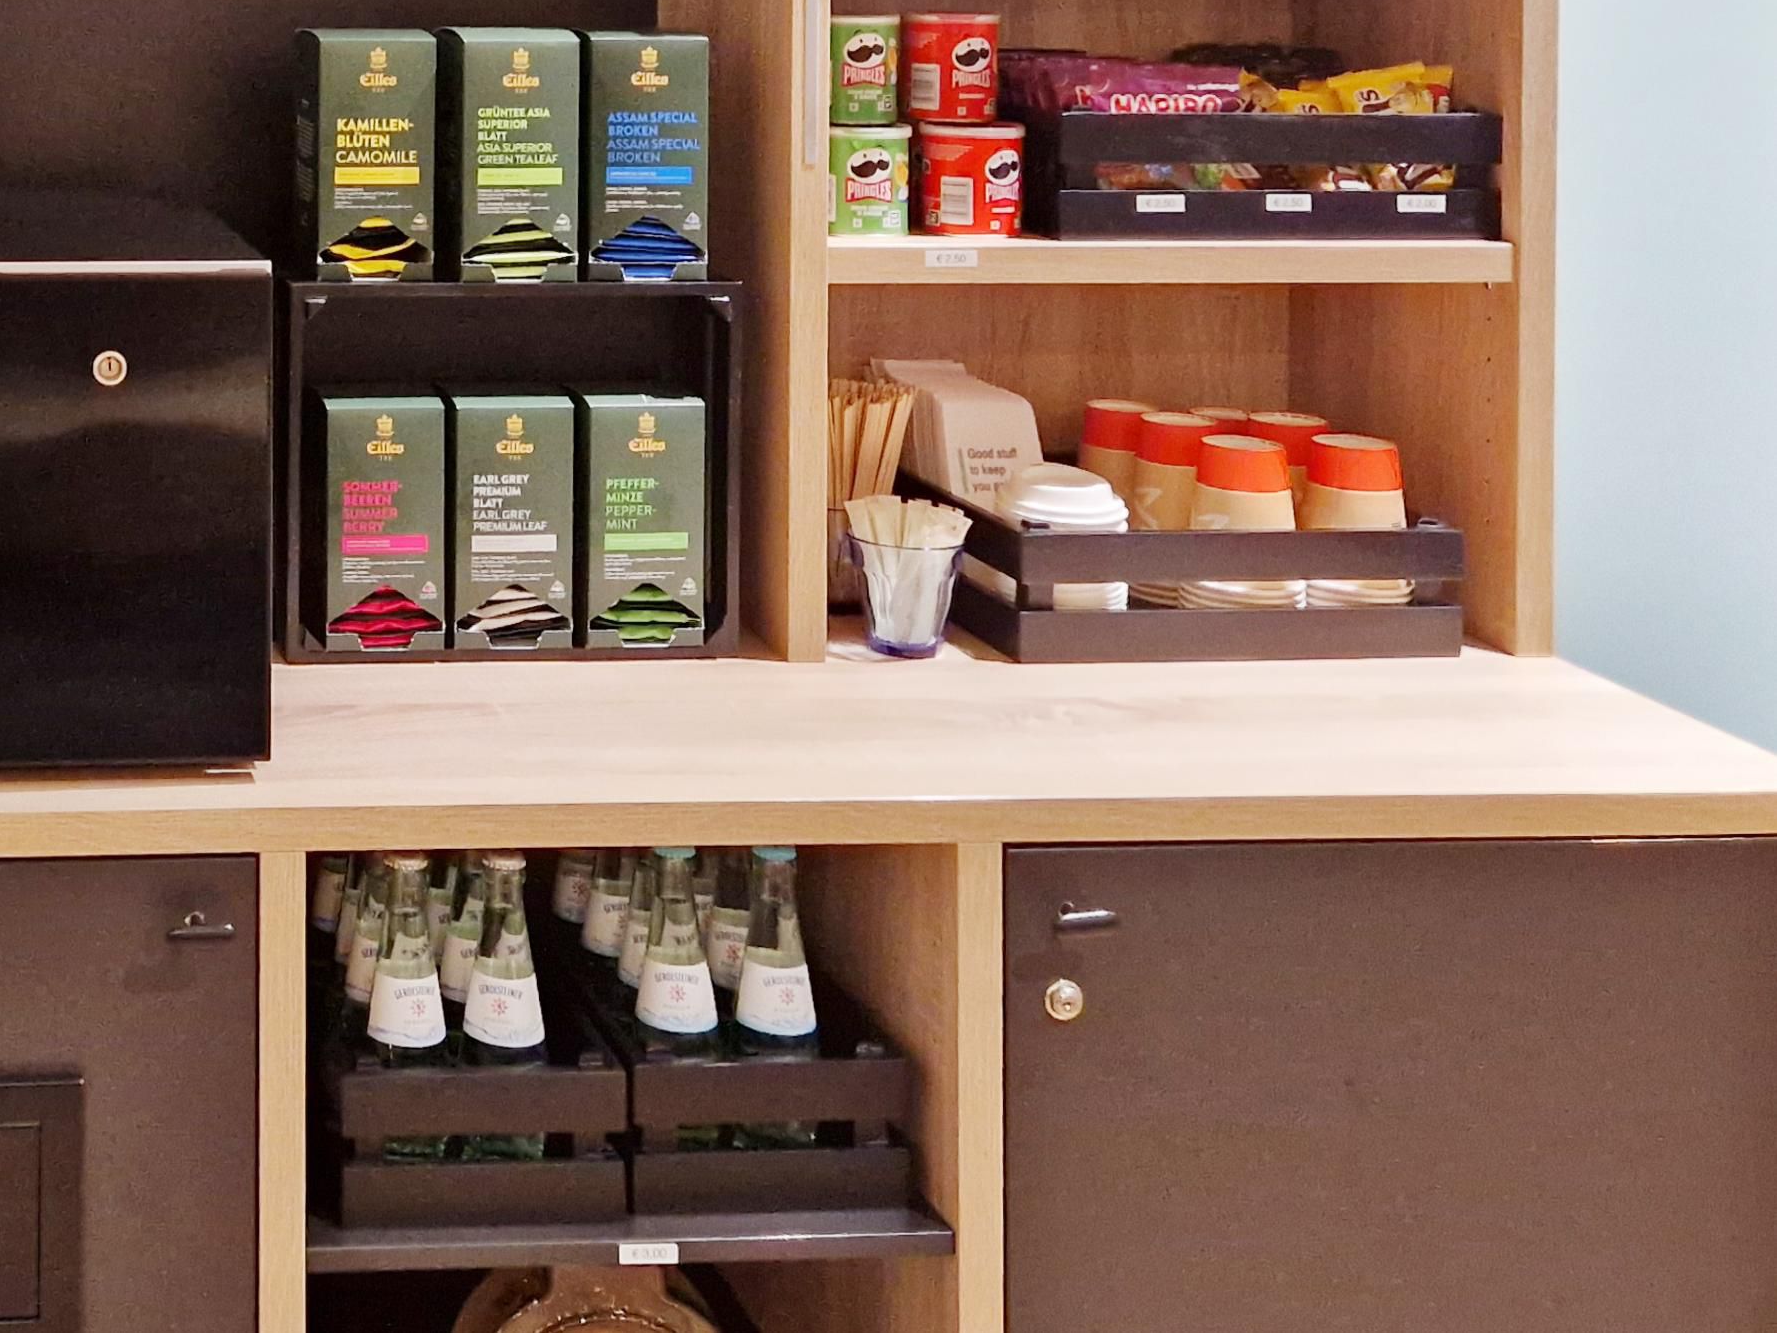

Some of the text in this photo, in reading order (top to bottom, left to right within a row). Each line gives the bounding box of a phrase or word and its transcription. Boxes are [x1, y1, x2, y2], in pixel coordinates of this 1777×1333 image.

[843, 65, 886, 86] PRINGLES
[478, 105, 550, 118] GRÜNTEE ASIA
[607, 112, 697, 124] ASSAM SPECIAL
[337, 118, 414, 132] KAMILLEN-
[478, 119, 528, 130] SUPERIOR
[478, 131, 507, 141] BLATT
[608, 125, 658, 137] BROKEN
[336, 132, 390, 147] BLÜTEN
[607, 139, 700, 150] ASSAM SPECIAL
[478, 143, 552, 153] ASIA SUPERIOR
[335, 150, 417, 164] CAMOMILE
[478, 154, 558, 164] GREEN TEA LEAF
[608, 151, 660, 163] BROKEN
[847, 179, 892, 202] PRINGLES
[967, 448, 994, 459] Good
[970, 464, 1006, 477] to keep
[473, 474, 529, 485] EARL GREY
[606, 478, 659, 490] PFEFFER-
[473, 486, 521, 497] PREMIUM
[473, 498, 503, 508] BLATT
[606, 492, 643, 503] MINZE
[473, 509, 531, 520] EARL GREY
[605, 505, 656, 516] PEPPER-
[473, 521, 548, 532] PREMIUM LEAF
[605, 519, 638, 530] MINT
